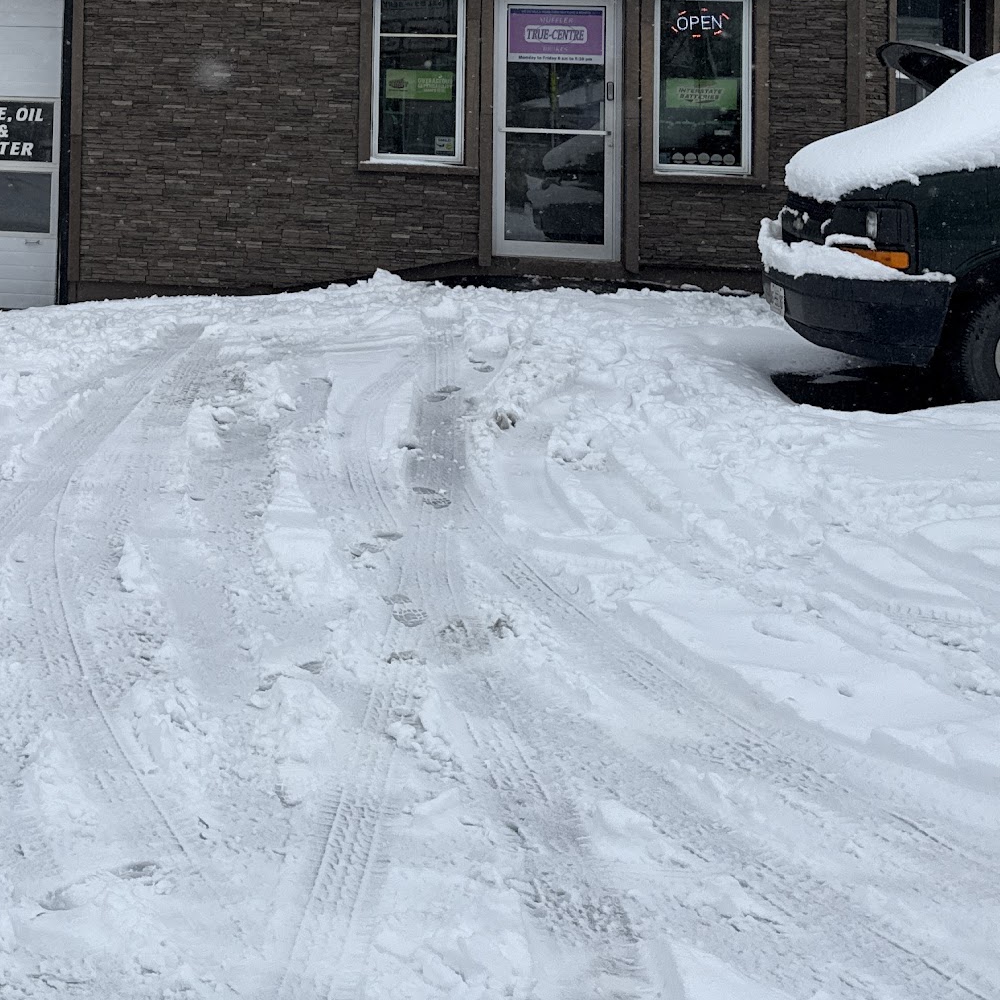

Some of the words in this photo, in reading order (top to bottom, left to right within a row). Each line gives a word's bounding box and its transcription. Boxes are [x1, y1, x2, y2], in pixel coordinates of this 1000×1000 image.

[677, 14, 722, 30] OPEN
[526, 28, 585, 41] TRUE-CENTRE
[16, 108, 44, 122] OIL
